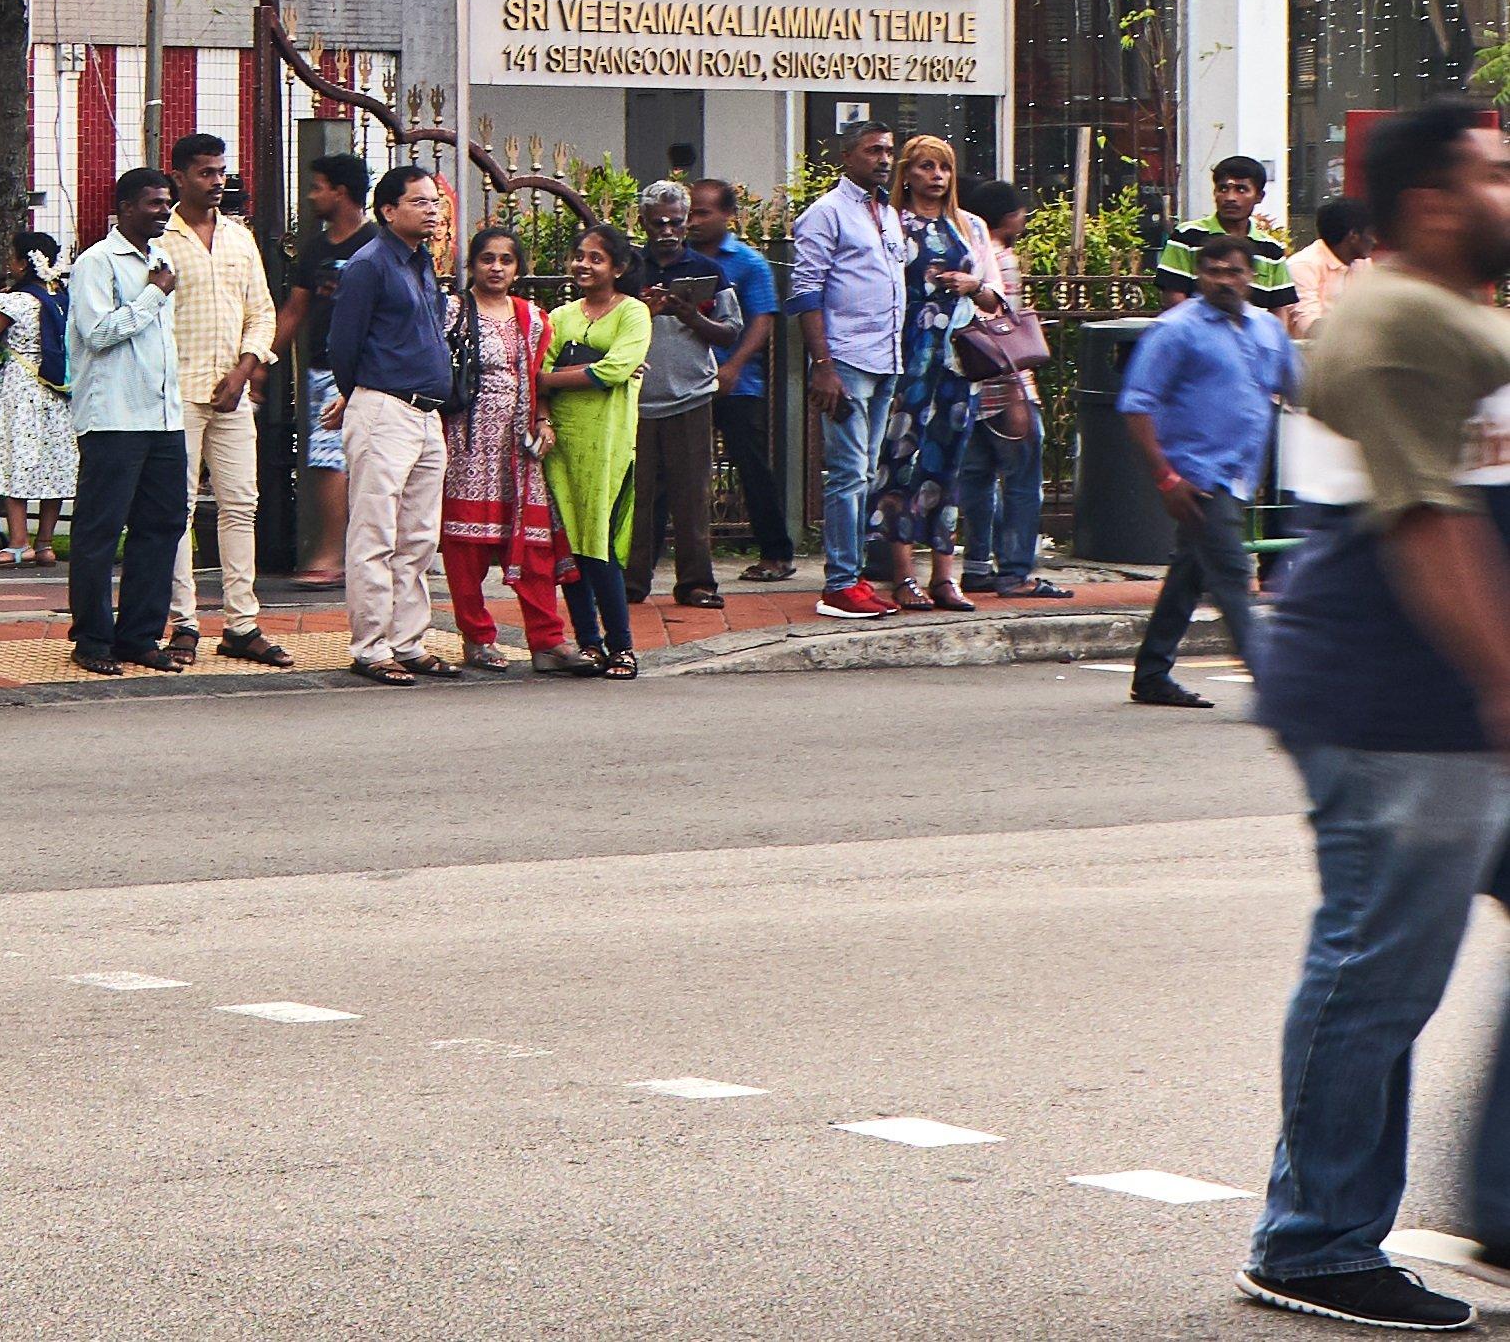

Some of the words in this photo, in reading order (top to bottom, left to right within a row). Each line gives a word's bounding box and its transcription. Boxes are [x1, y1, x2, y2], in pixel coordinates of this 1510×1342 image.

[871, 8, 978, 43] TEMPLE
[502, 44, 540, 72] 141
[546, 44, 691, 76] SERANGOON
[697, 48, 768, 82] ROAD,
[770, 50, 902, 81] SINGAPORE
[905, 53, 978, 83] 218042
